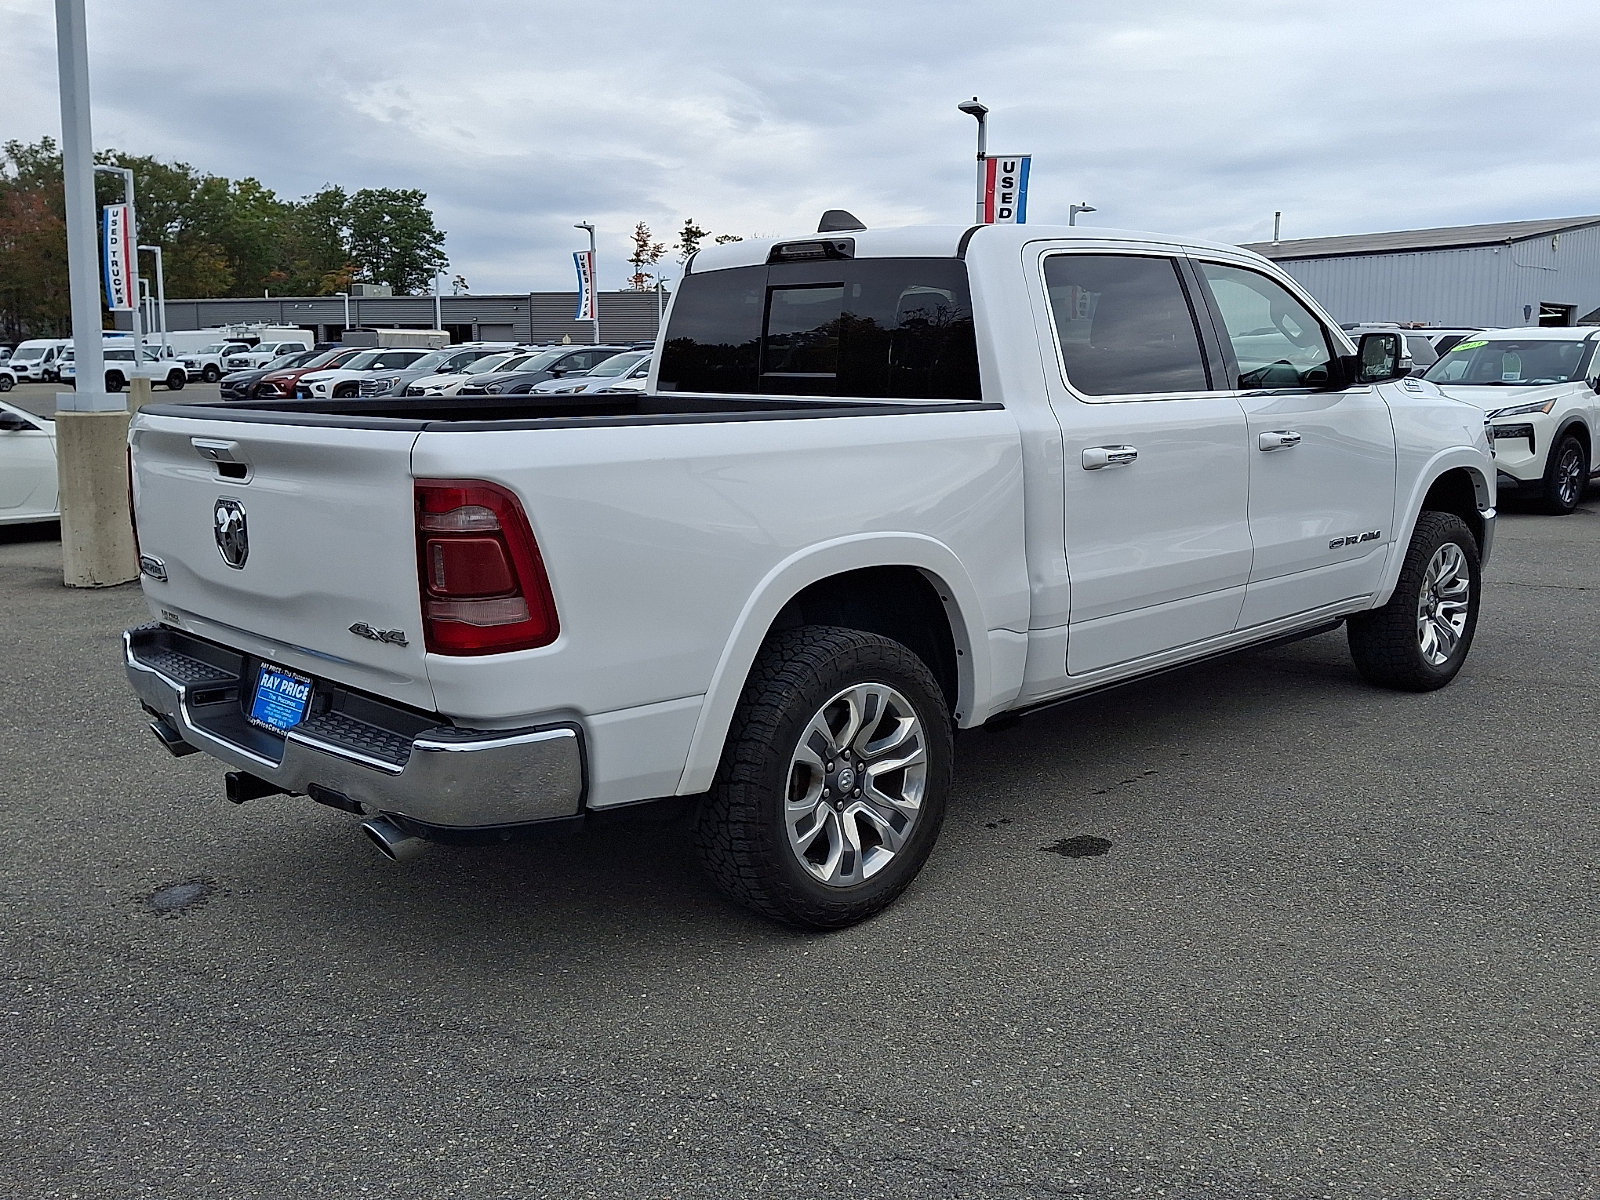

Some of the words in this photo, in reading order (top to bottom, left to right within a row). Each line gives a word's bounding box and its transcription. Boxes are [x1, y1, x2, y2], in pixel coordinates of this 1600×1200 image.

[998, 161, 1016, 219] USED
[110, 210, 119, 245] USED
[110, 251, 124, 304] TRUCKS
[579, 254, 589, 284] USED
[1345, 530, 1381, 546] RAM
[260, 673, 280, 690] RAY
[280, 679, 309, 700] PRICE
[268, 692, 277, 700] The
[277, 695, 296, 708] Poconos
